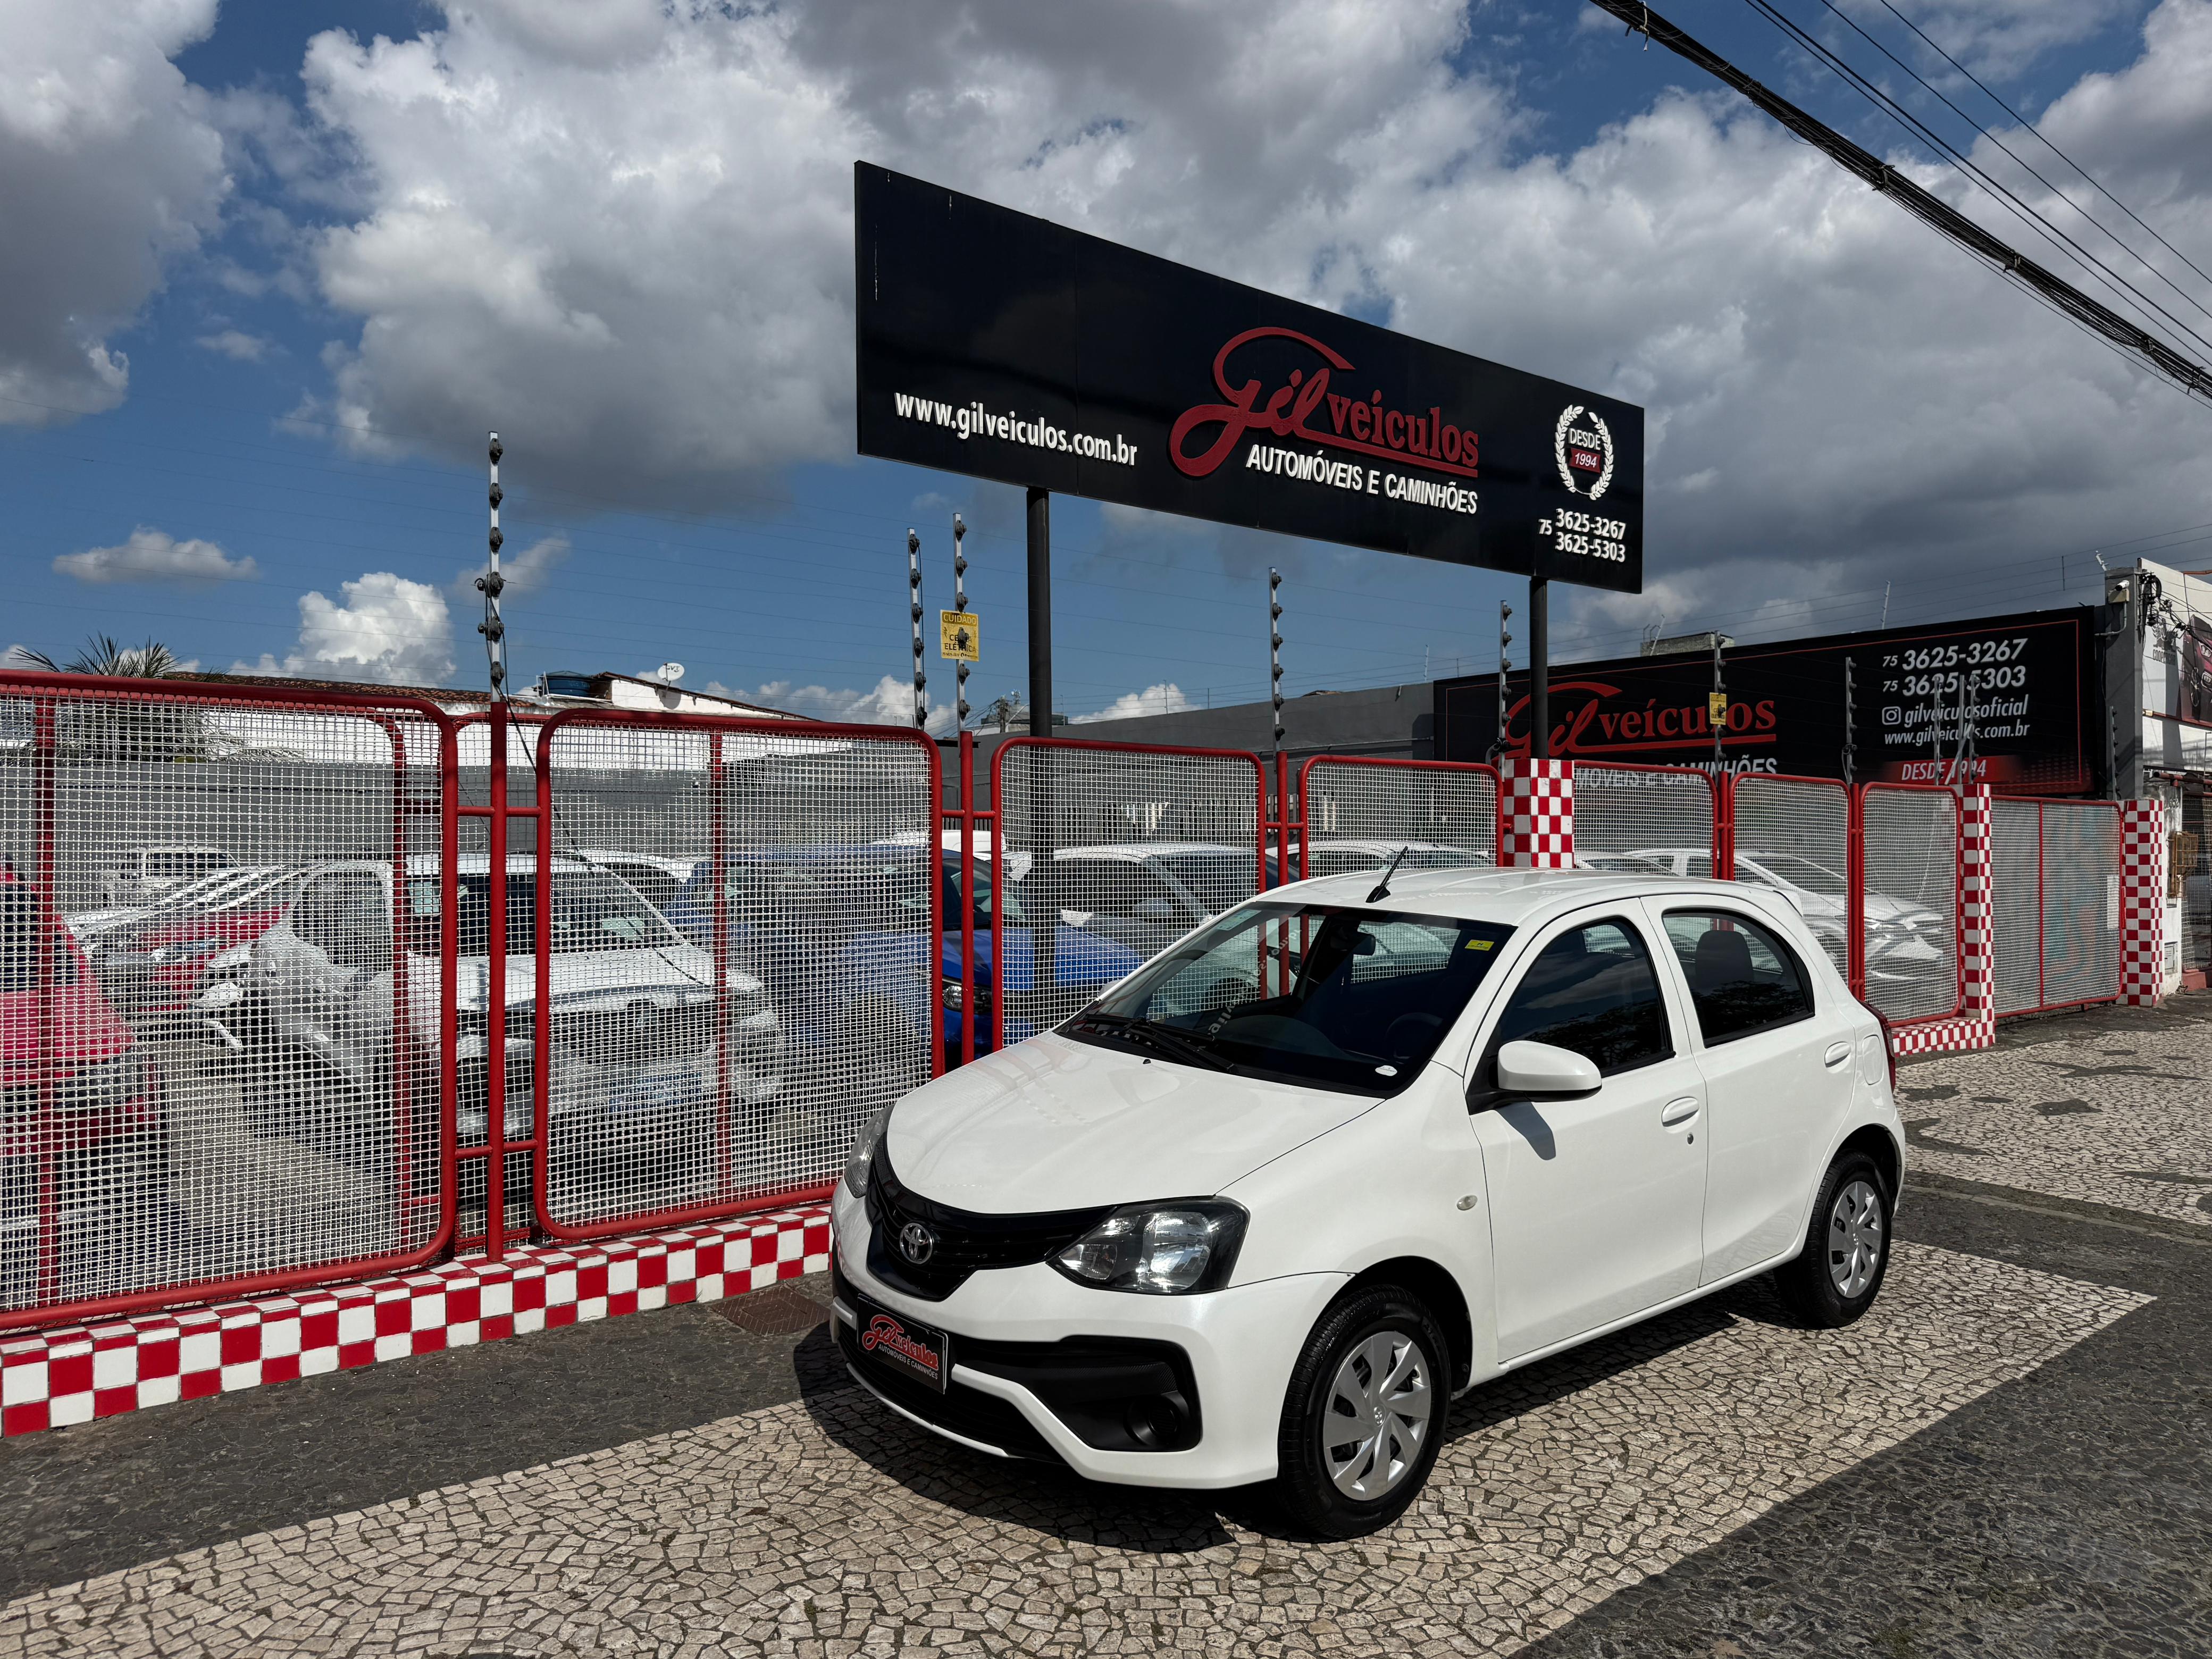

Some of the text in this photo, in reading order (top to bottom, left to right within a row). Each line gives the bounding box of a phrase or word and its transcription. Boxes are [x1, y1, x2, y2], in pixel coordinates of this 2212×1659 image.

[894, 392, 1137, 466] www.gilveiculos.com.br
[1568, 428, 1602, 450] DESDE
[1574, 453, 1597, 467] 1994
[1246, 443, 1478, 514] AUTOMÓVEIS E CAMINHÕES
[1539, 508, 1627, 540] 75 3625-3267
[1555, 532, 1626, 562] 3625-5303
[943, 614, 976, 625] CUIDADO
[1882, 638, 2028, 671] 75 3625-3267
[1883, 681, 1898, 692] 75
[1598, 698, 1776, 739] veícuos
[878, 1345, 907, 1364] AUTOMÓVEIS
